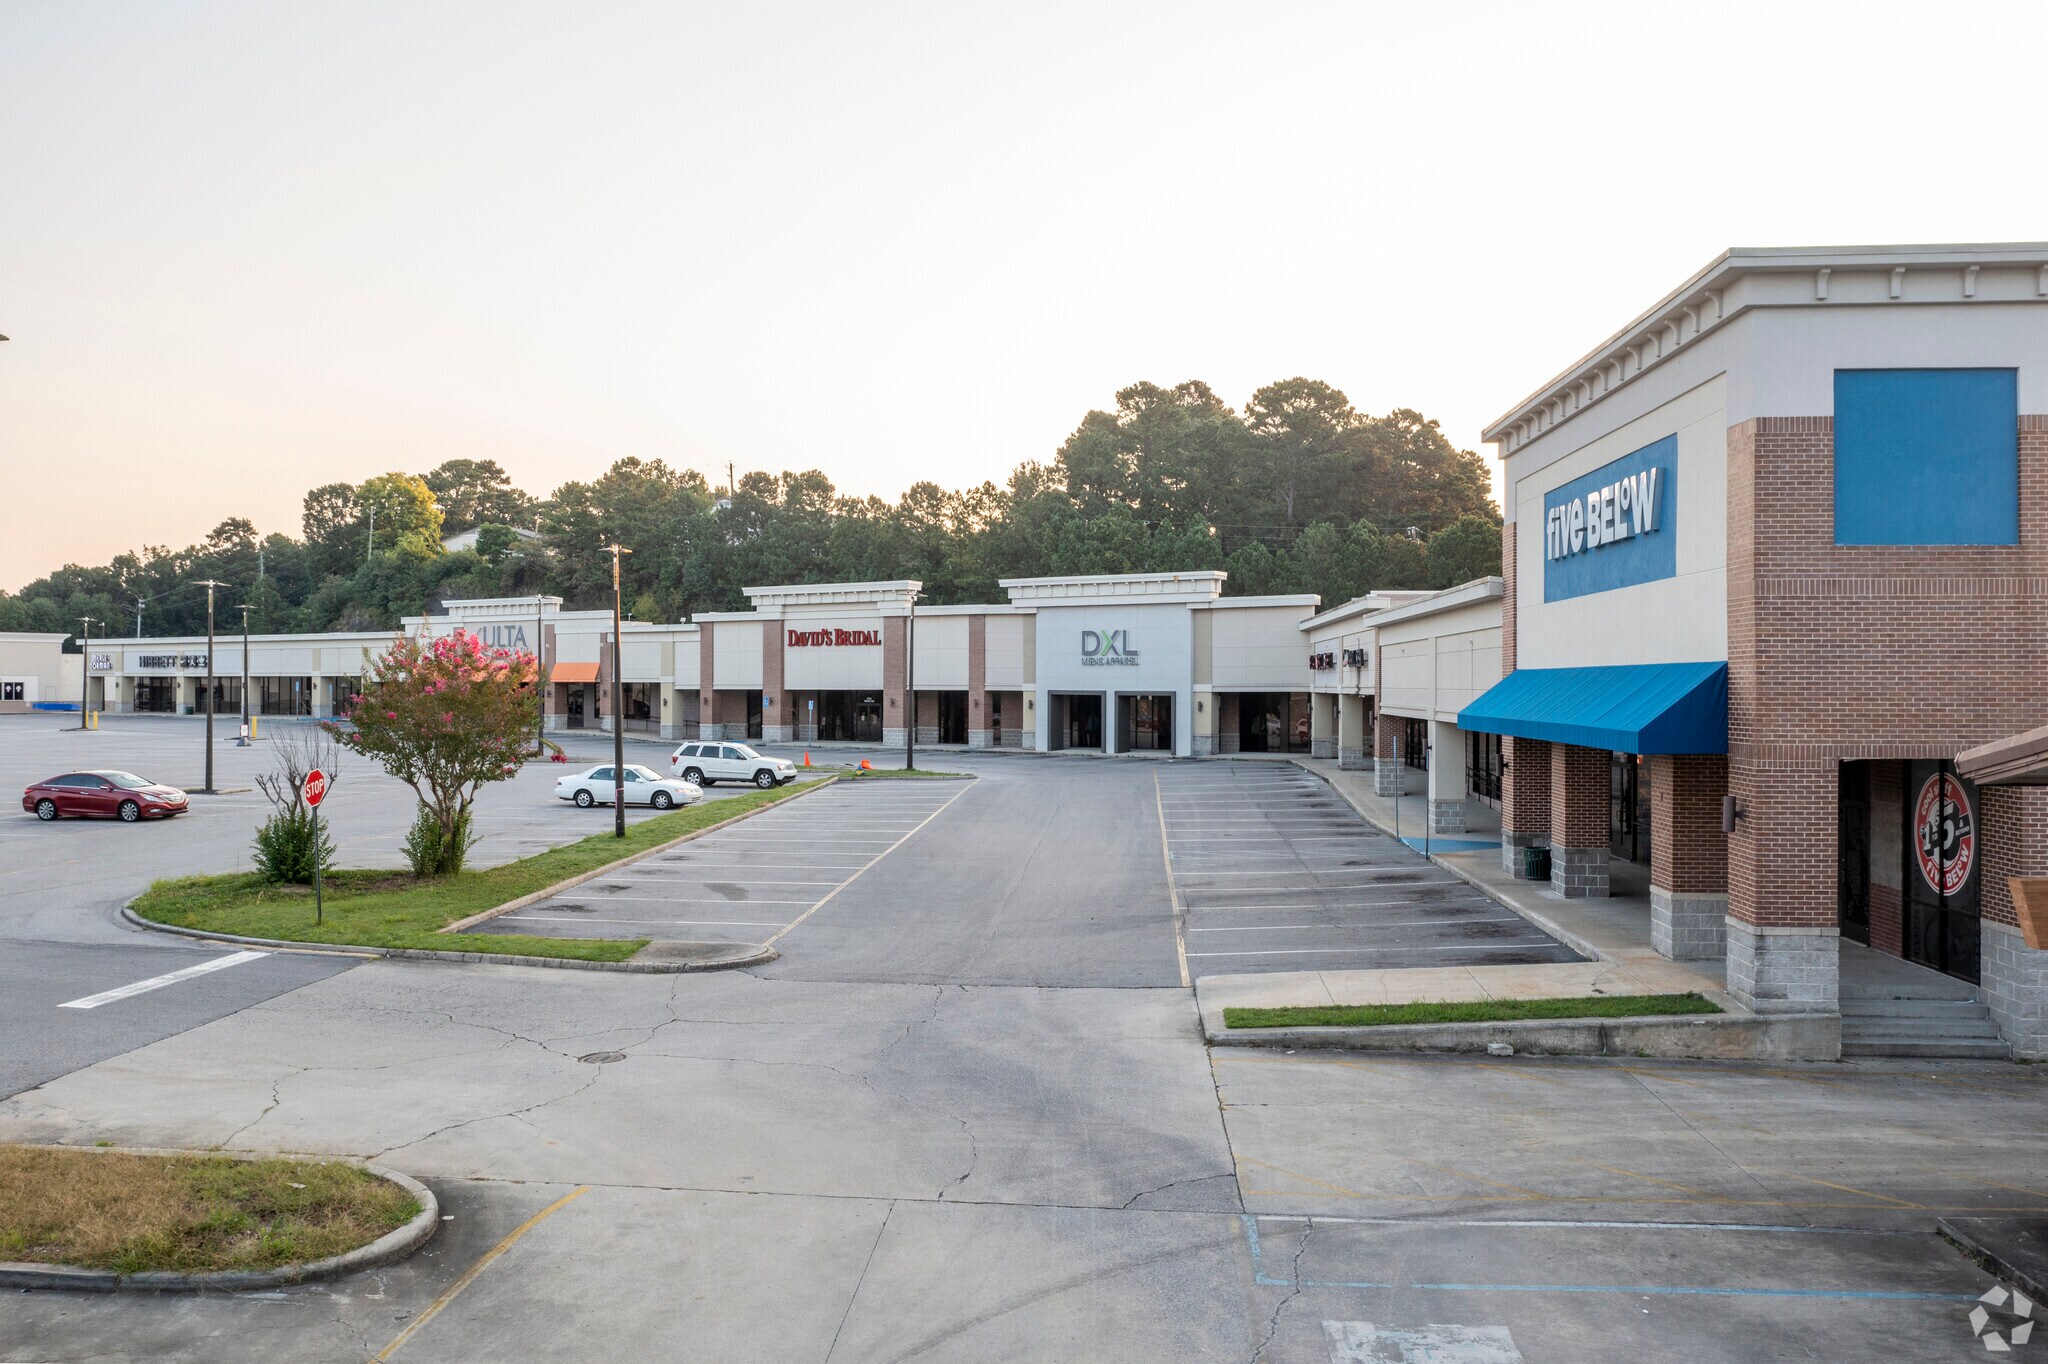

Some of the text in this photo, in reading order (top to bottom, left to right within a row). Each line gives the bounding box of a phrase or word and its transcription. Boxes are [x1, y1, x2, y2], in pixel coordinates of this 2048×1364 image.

[482, 625, 528, 648] ULTA
[787, 628, 881, 647] DAVID'S BRIDAL
[1082, 629, 1140, 656] DXL
[139, 655, 177, 668] HIBBETT
[1105, 657, 1140, 666] APPAREL
[306, 778, 325, 798] STOP
